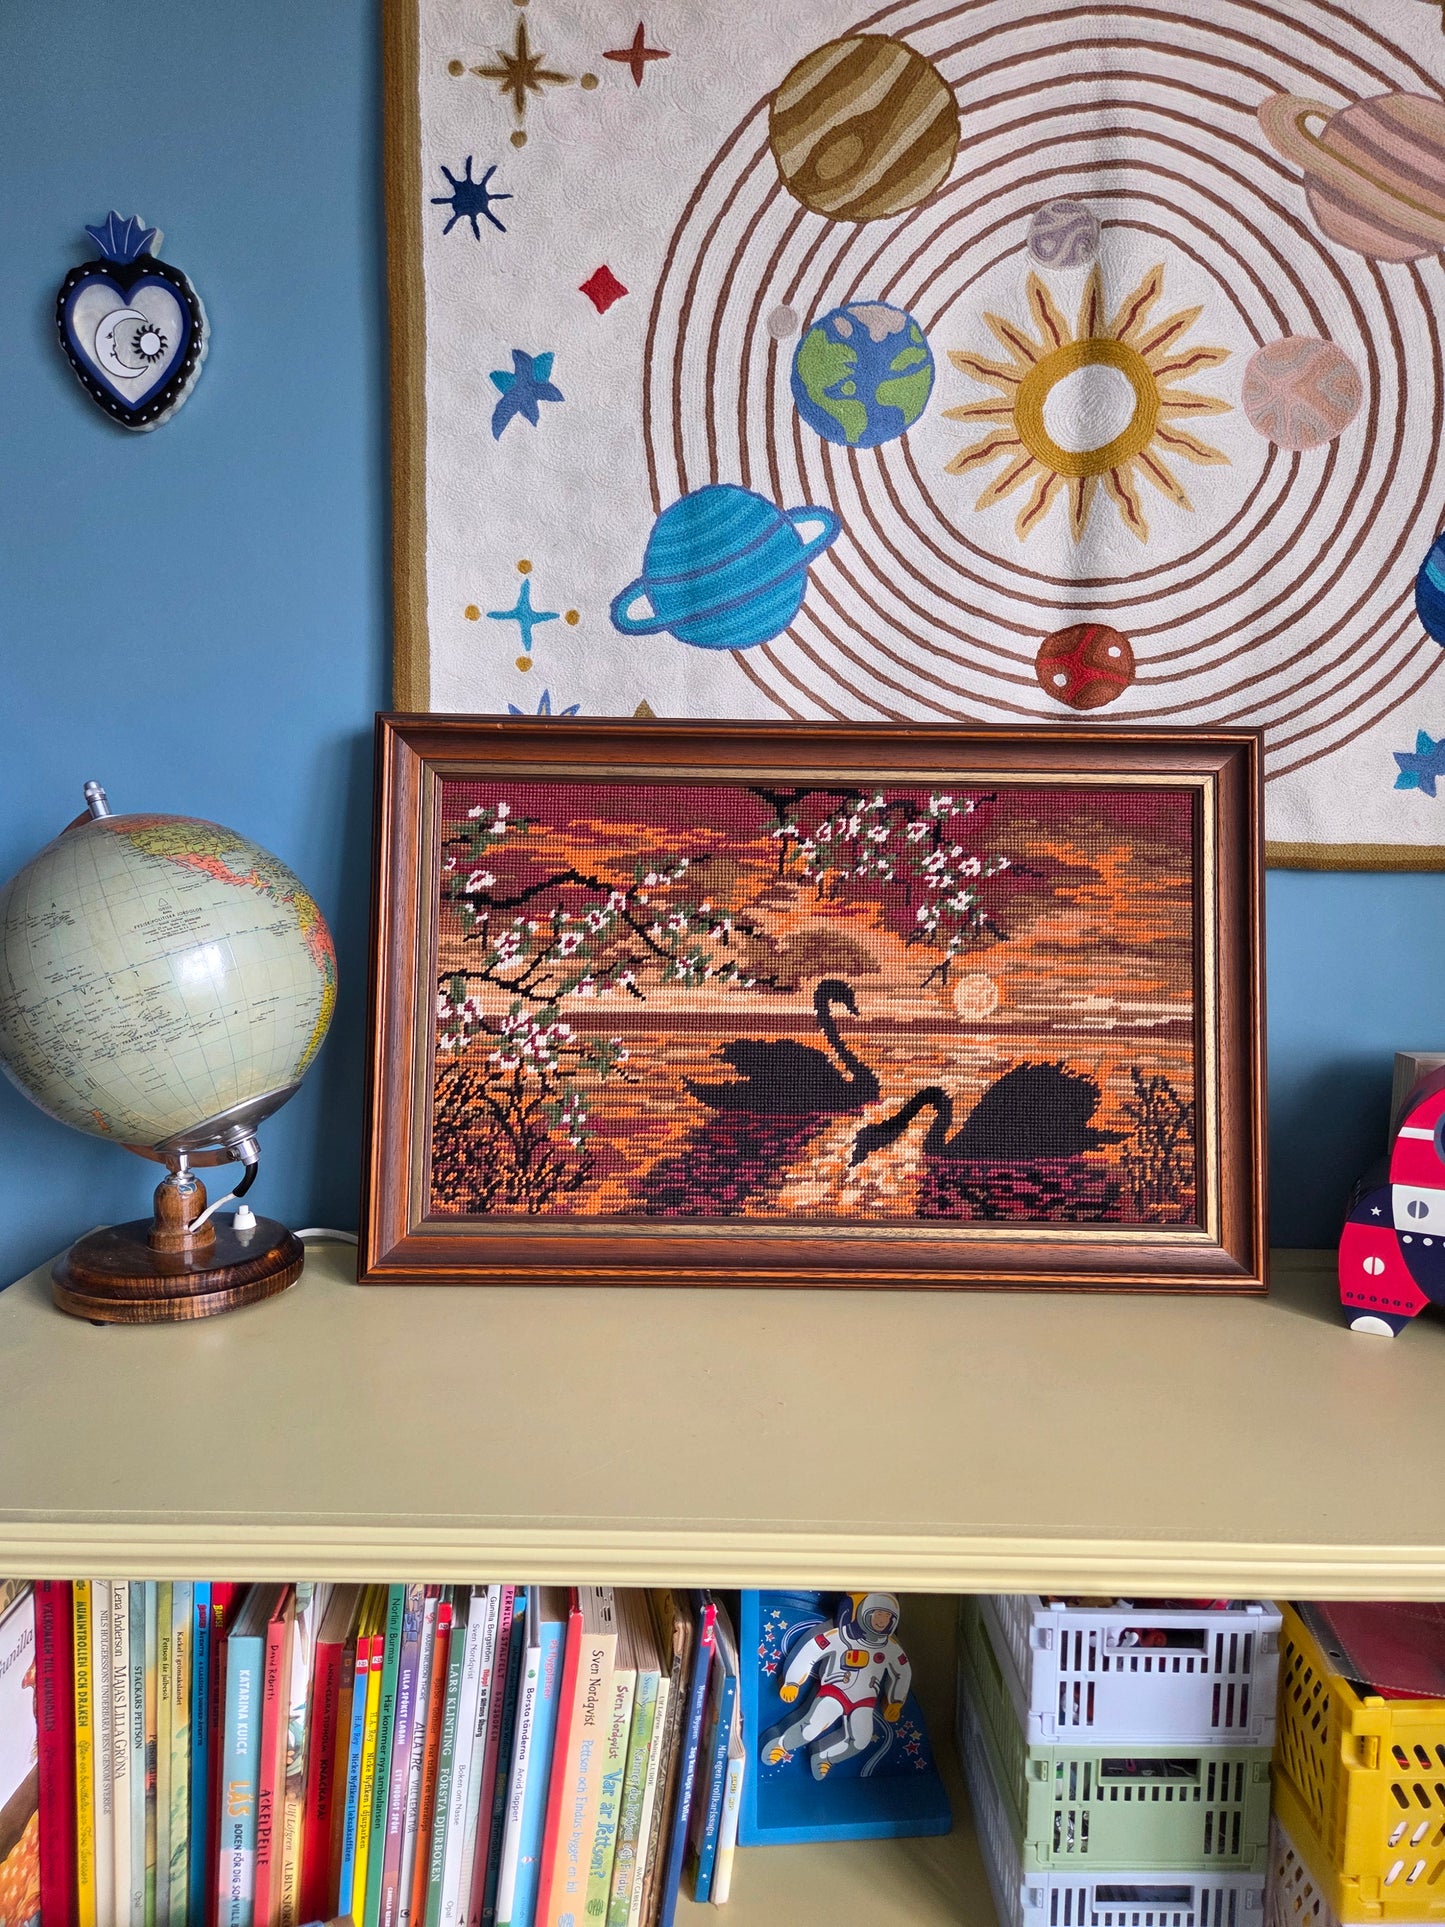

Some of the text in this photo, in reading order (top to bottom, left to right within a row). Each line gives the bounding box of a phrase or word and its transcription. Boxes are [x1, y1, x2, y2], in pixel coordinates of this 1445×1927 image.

[114, 1586, 126, 1610] Lena
[391, 1598, 400, 1625] Norlin
[502, 1590, 513, 1633] PERNILLA
[100, 1610, 108, 1628] NILS
[213, 1604, 223, 1628] BAMSE
[484, 1596, 497, 1663] Gunilla Bergström
[114, 1613, 126, 1657] Anderson
[387, 1633, 397, 1665] Burman
[44, 1657, 54, 1674] TILL
[268, 1645, 279, 1701] David Roberts
[402, 1669, 411, 1689] LILLA
[543, 1652, 557, 1699] flygplatsen
[77, 1671, 88, 1689] OCH
[642, 1676, 653, 1695] Sven
[78, 1692, 89, 1727] DRAKEN
[236, 1669, 250, 1755] KATARINA KUICK
[384, 1694, 393, 1712] Här
[399, 1691, 409, 1718] SPÖKET
[135, 1713, 143, 1749] PETTSON
[352, 1732, 361, 1746] Rey
[367, 1730, 376, 1743] Rey
[380, 1715, 391, 1755] kommer
[413, 1721, 426, 1749] ALLA
[115, 1738, 127, 1780] GRÖNA
[352, 1753, 360, 1773] Nicke
[365, 1751, 374, 1773] Nicke
[511, 1687, 535, 1823] Borsta tänderna Arvid Tappert
[689, 1744, 698, 1757] Jag
[103, 1755, 111, 1780] GENOM
[377, 1757, 387, 1773] nya
[431, 1663, 459, 1882] LARS KLINTING FÖRSTA DJURBOKEN
[444, 1623, 480, 1919] Sven Nordqvist Boken om Nasse Opal
[566, 1649, 605, 1894] Sven Nordqvist Pettson och Findus bygger en bil
[348, 1775, 359, 1804] Nyfiken
[363, 1774, 373, 1803] Nyfiken
[411, 1779, 420, 1796] VILL
[590, 1685, 628, 1879] Sven Nordqvist Var är Pettson?
[705, 1744, 727, 1836] Min egen trollkarlssaga
[103, 1782, 111, 1815] SVERIGE
[228, 1780, 255, 1817] LÄS
[374, 1775, 386, 1829] ambulansen
[681, 1805, 689, 1822] bilar
[233, 1823, 243, 1850] BOKEN
[360, 1809, 372, 1849] djurparken
[232, 1851, 244, 1868] FÖR
[283, 1802, 297, 1892] Ulf Löfgren ALBIN
[232, 1869, 241, 1883] DIG
[231, 1884, 240, 1901] SOM
[231, 1902, 240, 1921] VILL
